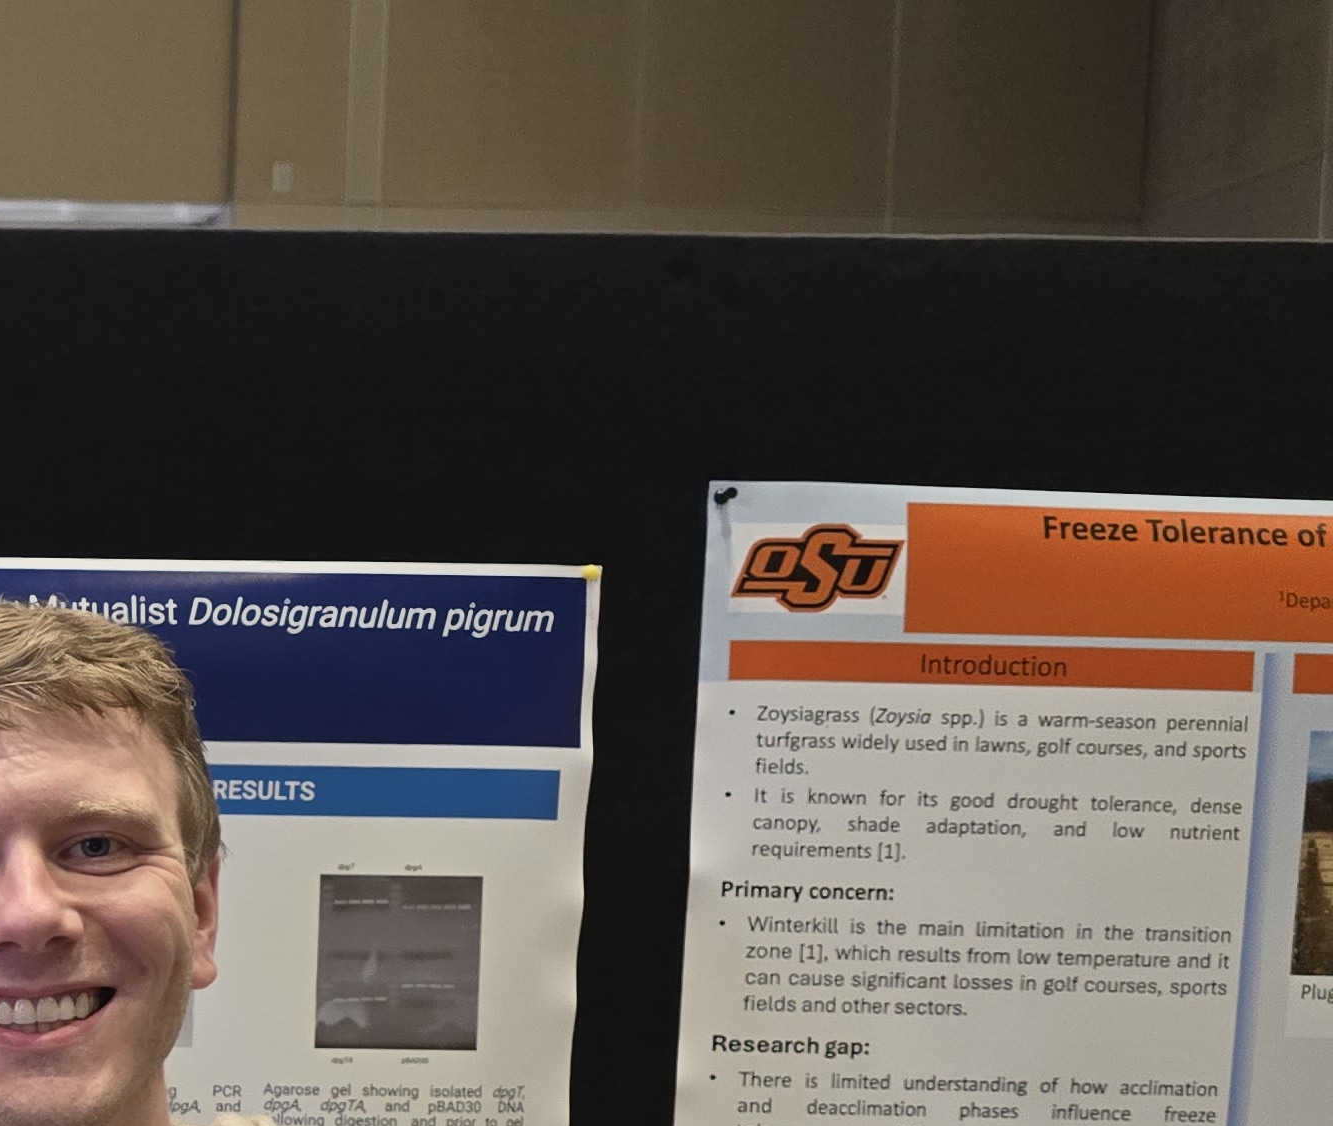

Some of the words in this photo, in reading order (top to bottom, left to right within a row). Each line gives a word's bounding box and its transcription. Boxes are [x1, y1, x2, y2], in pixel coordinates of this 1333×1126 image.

[1043, 515, 1140, 543] Freeze
[1144, 518, 1290, 548] Tolerance
[1296, 522, 1328, 550] of
[731, 523, 904, 613] OSU
[188, 596, 437, 635] Dolosigranulum
[442, 601, 555, 639] pigrum
[920, 652, 1068, 678] Introduction
[756, 704, 860, 726] Zoysiagrass
[868, 705, 932, 728] (Zoysia
[940, 708, 986, 730] spp.)
[994, 709, 1009, 728] is
[1016, 714, 1028, 728] a
[1037, 714, 1157, 731] warm-season
[1165, 715, 1249, 735] perennial
[213, 779, 316, 801] RESULTS
[721, 879, 804, 904] Primary
[809, 885, 895, 901] concern:
[712, 1034, 821, 1054] Research
[824, 1040, 871, 1060] gap:
[262, 1081, 321, 1100] Agarose
[329, 1082, 352, 1100] gel
[361, 1083, 420, 1101] showing
[429, 1084, 483, 1100] isolated
